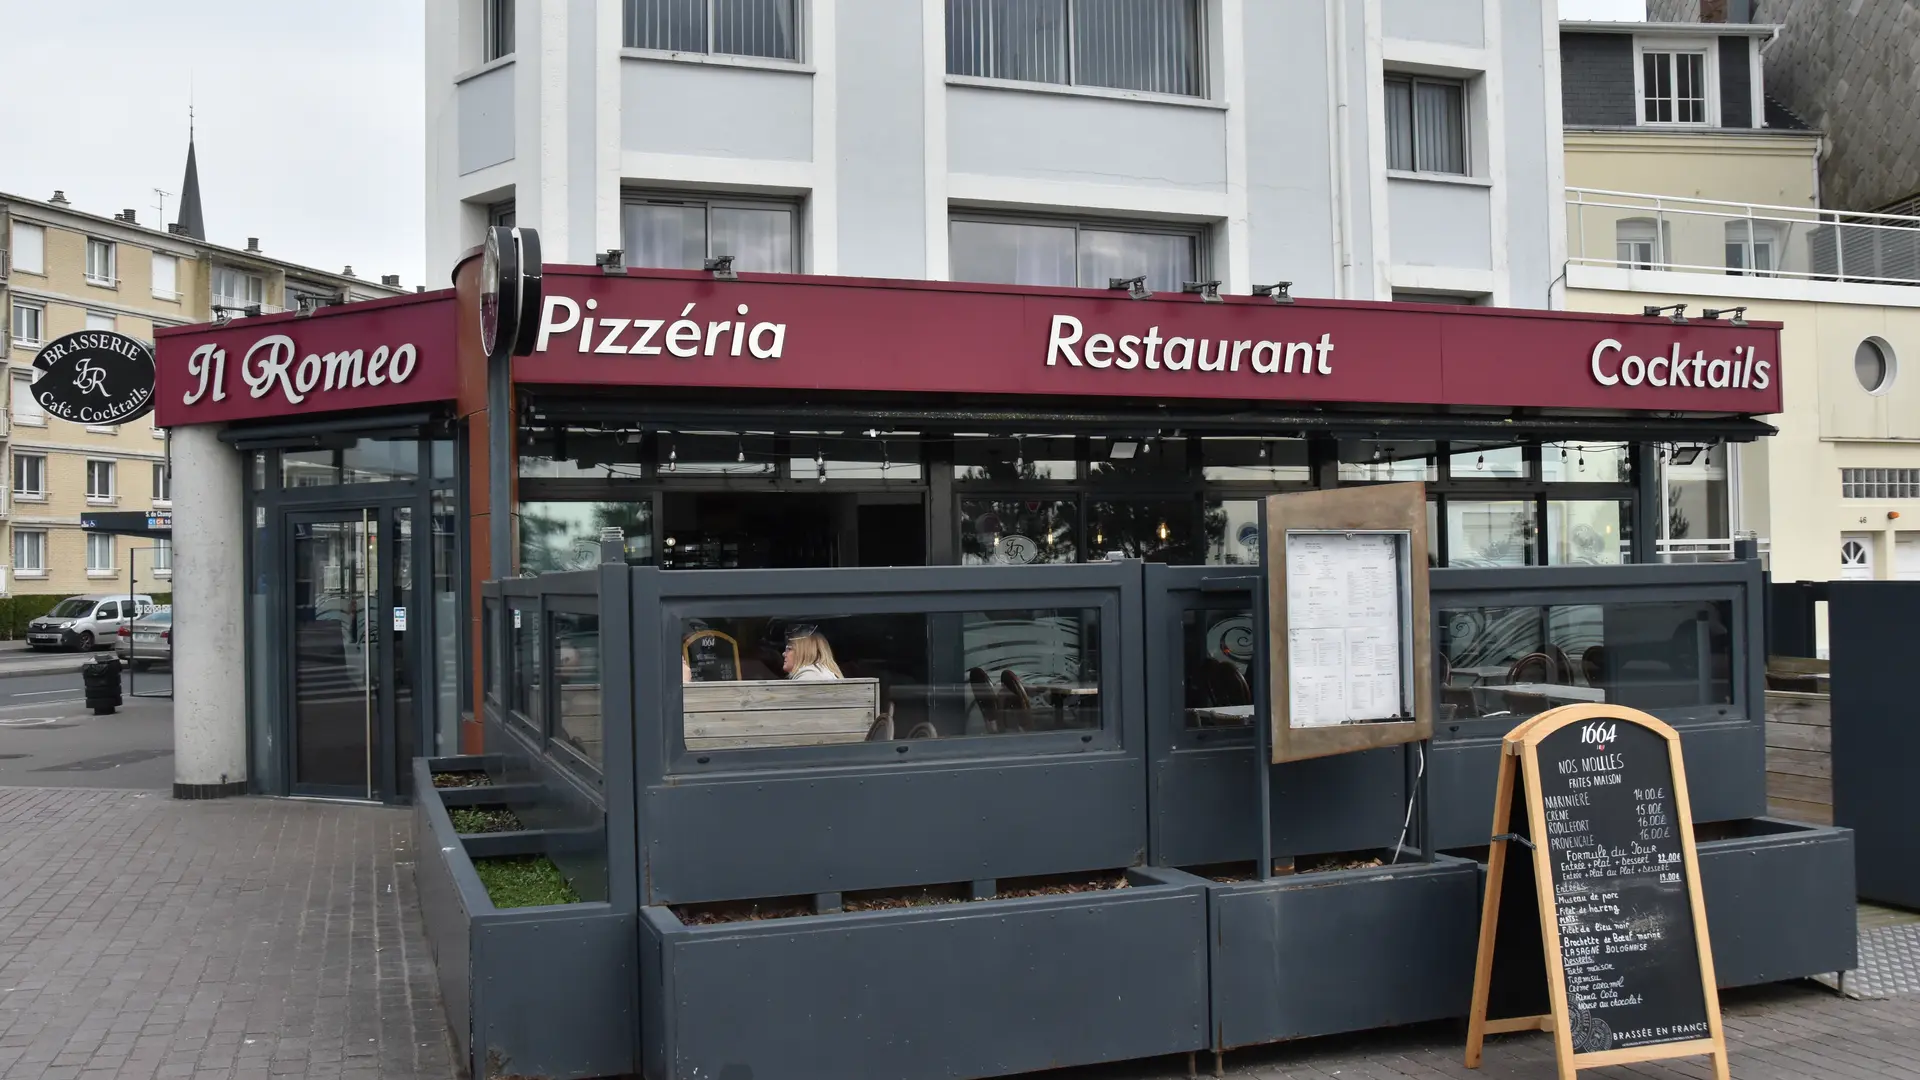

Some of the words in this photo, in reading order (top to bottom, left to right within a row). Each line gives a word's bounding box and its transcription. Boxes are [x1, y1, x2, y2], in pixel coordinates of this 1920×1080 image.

[536, 295, 786, 359] Pizzéria
[42, 334, 141, 366] BRASSERIE
[1046, 314, 1334, 375] Restaurant
[183, 343, 226, 405] Il
[241, 334, 417, 404] Romeo
[1591, 338, 1771, 389] Cocktails
[40, 391, 72, 419] Café
[80, 387, 148, 421] Cocktails
[1581, 721, 1617, 744] 1664
[1558, 759, 1578, 774] NOS
[1569, 777, 1592, 789] FRITES
[1594, 774, 1622, 786] MAISON
[1611, 845, 1627, 857] du
[1602, 892, 1619, 903] porc
[1589, 904, 1620, 914] hareng
[1611, 993, 1643, 1007] chocolat
[1613, 1027, 1652, 1040] BRASSÉE
[1656, 1027, 1668, 1036] EN
[1672, 1022, 1708, 1033] FRANCE
